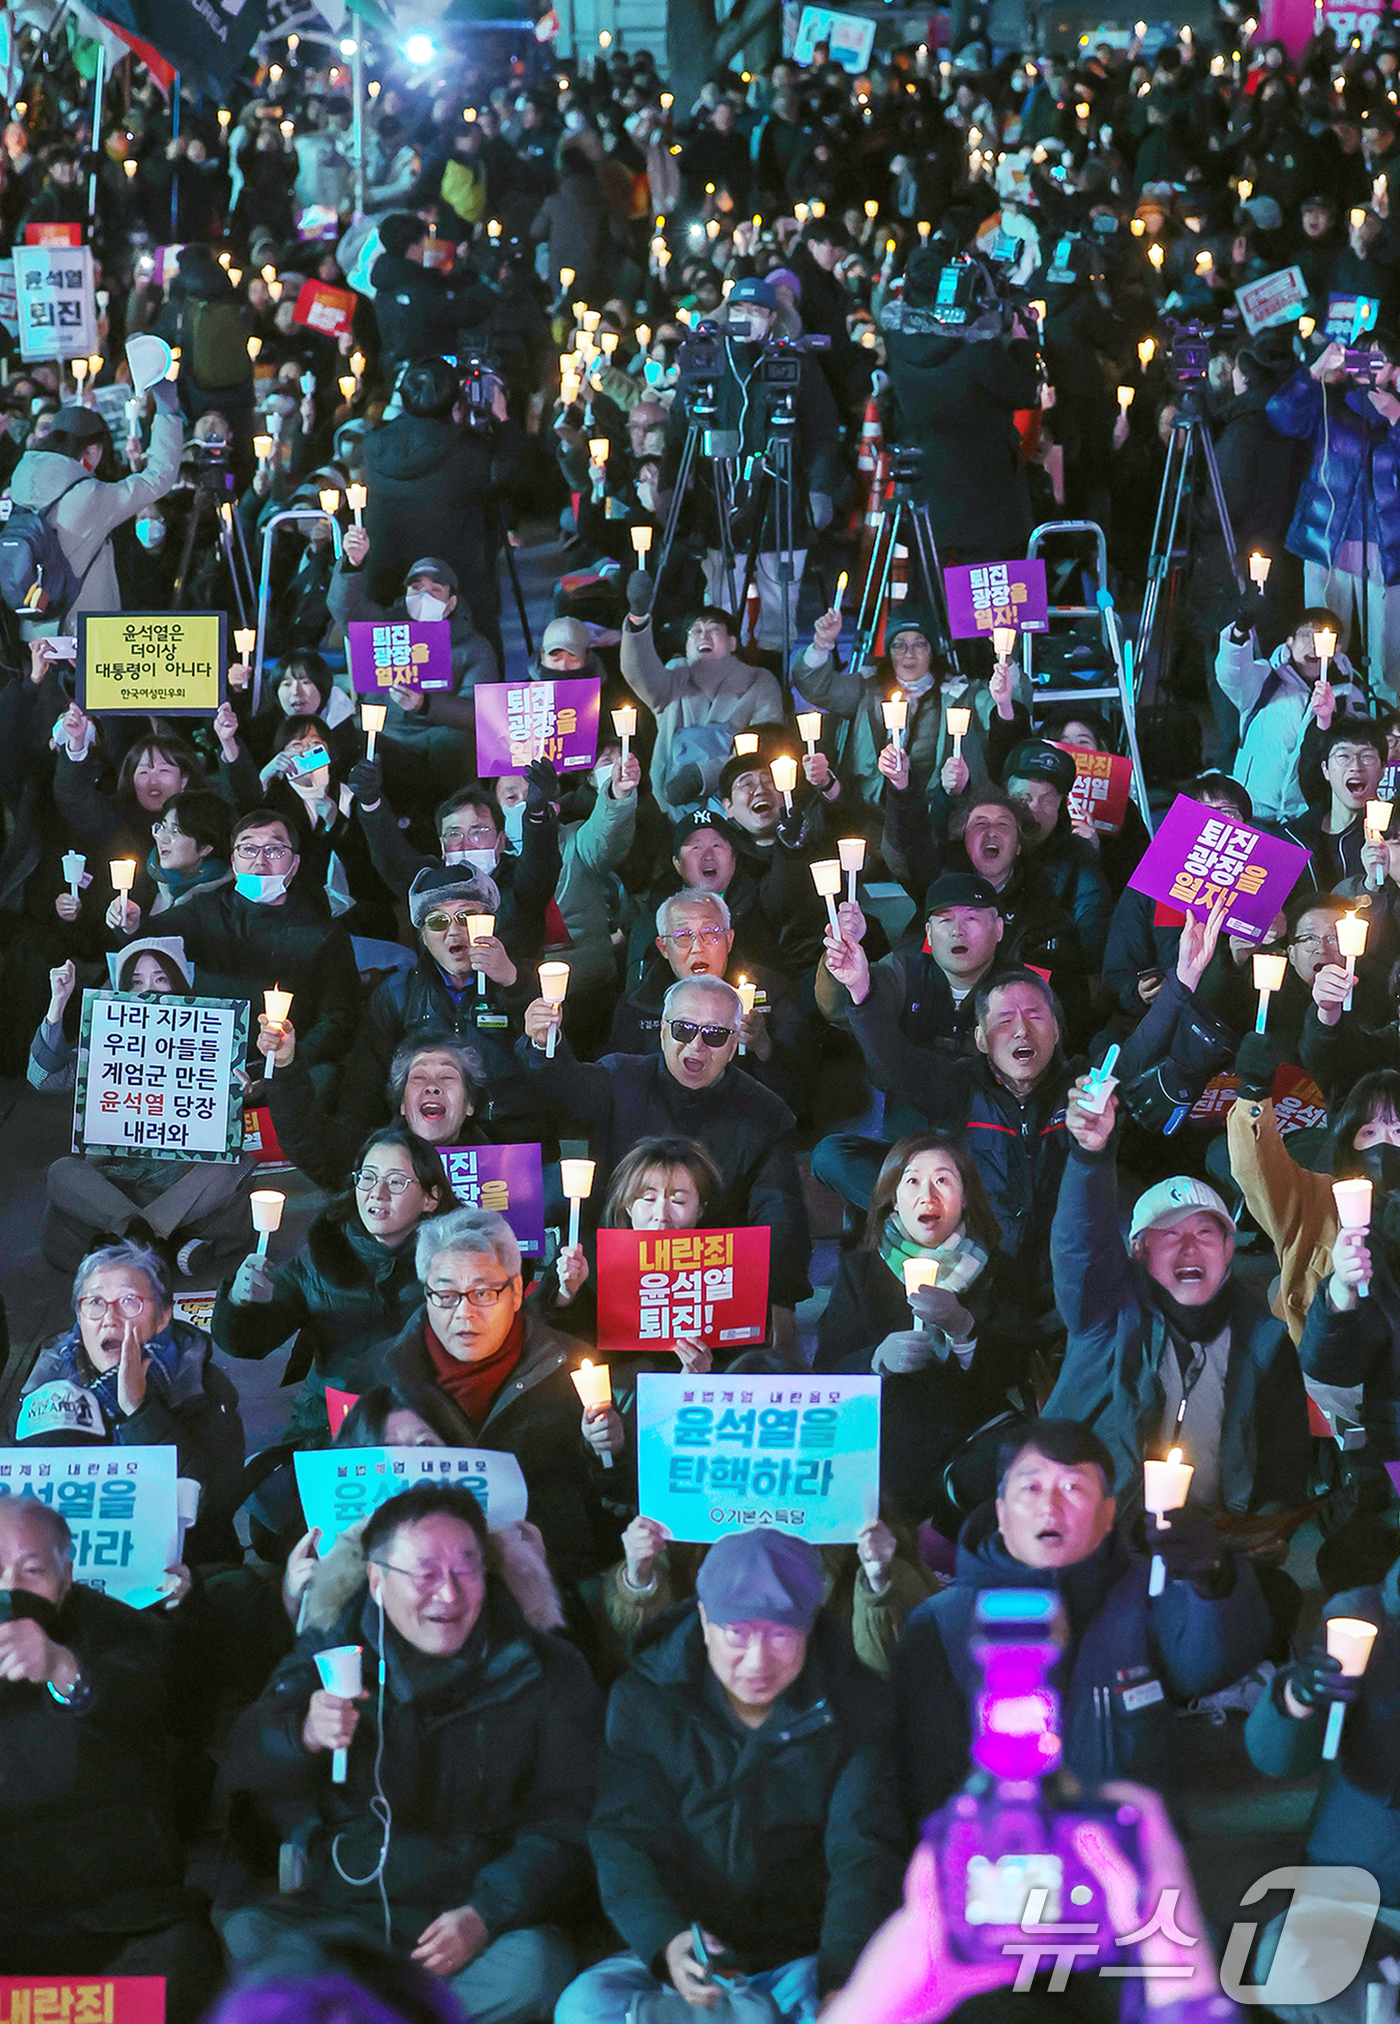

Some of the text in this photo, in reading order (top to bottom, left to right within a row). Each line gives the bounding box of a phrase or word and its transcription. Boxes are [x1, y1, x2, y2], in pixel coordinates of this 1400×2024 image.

[30, 301, 82, 327] 퇴진
[969, 564, 1009, 589] 퇴진
[974, 605, 1018, 630] 열자!
[122, 624, 185, 642] 윤석열은
[372, 624, 410, 647] 퇴진
[131, 643, 177, 661] 더이상
[95, 662, 212, 681] 대통령이 아니다
[375, 665, 419, 687] 열자!
[120, 688, 185, 699] 한국여성민우회
[507, 684, 555, 714] 퇴진
[508, 708, 577, 741] 광장을
[1072, 751, 1113, 778] 란죄
[1072, 775, 1110, 800] 석열
[1066, 797, 1096, 820] 진!
[1196, 818, 1260, 861] 퇴진
[1183, 844, 1269, 896] 광장을
[1168, 872, 1239, 914] 열자!
[107, 1005, 222, 1034] 나라 지키는
[103, 1033, 220, 1063] 우리 아들들
[101, 1062, 218, 1091] 계엄군 만든
[99, 1090, 216, 1119] 윤석열 당장
[1274, 1096, 1328, 1130] 윤석
[124, 1121, 190, 1147] 내려와
[440, 1151, 478, 1184] 진
[639, 1233, 734, 1271] 내란죄
[639, 1267, 734, 1306] 윤석열
[639, 1304, 714, 1339] 퇴진!
[675, 1406, 838, 1448] 윤석열을
[68, 1462, 138, 1476] 내란음모
[668, 1455, 834, 1496] 탄핵하라
[727, 1509, 805, 1525] 기본소득당
